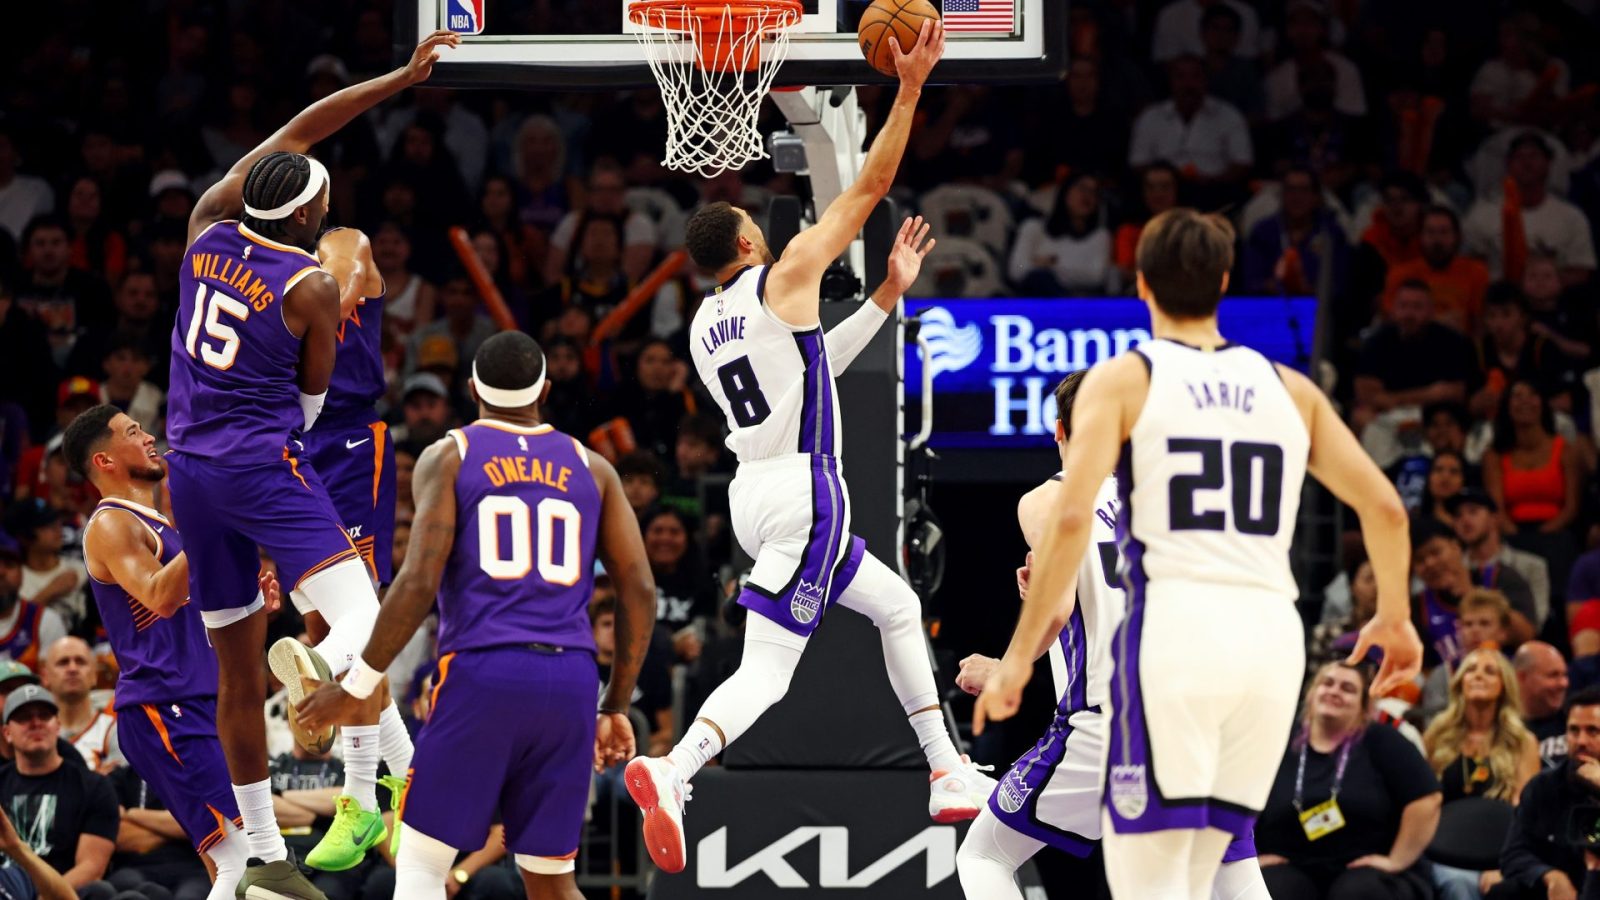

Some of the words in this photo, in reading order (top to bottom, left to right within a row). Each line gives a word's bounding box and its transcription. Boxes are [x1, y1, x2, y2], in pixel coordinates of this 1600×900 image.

[451, 14, 470, 29] NBA
[192, 253, 274, 312] WILLIAMS
[186, 282, 249, 371] 15
[701, 316, 746, 355] LAVINE
[717, 354, 772, 428] 8
[483, 456, 572, 492] O'NEALE
[1167, 437, 1283, 536] 20
[478, 495, 581, 586] 00
[697, 826, 957, 888] KIA
